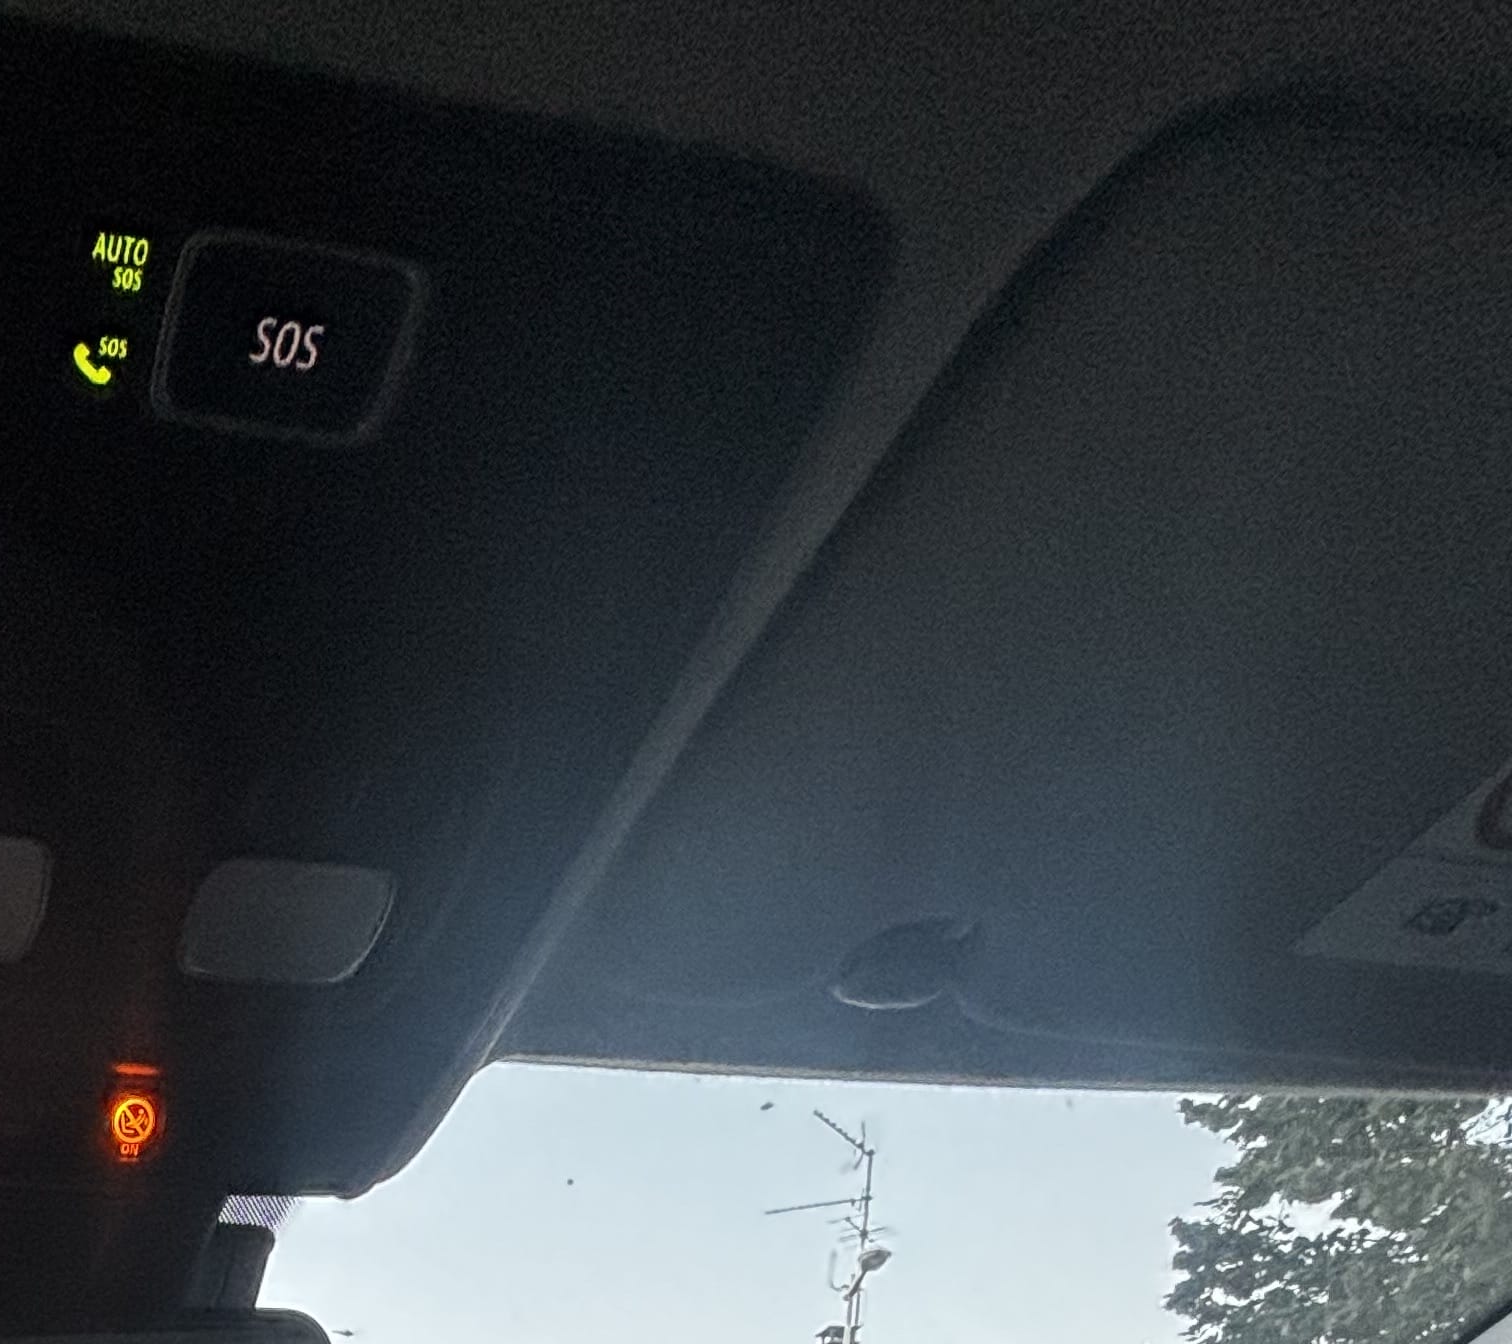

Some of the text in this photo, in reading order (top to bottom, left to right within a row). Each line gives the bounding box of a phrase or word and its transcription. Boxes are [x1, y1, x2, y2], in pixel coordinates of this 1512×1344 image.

[92, 232, 149, 267] AUTO
[112, 266, 143, 292] SOS
[98, 336, 128, 359] SOS
[249, 316, 325, 371] SOS
[121, 1144, 139, 1157] ON
